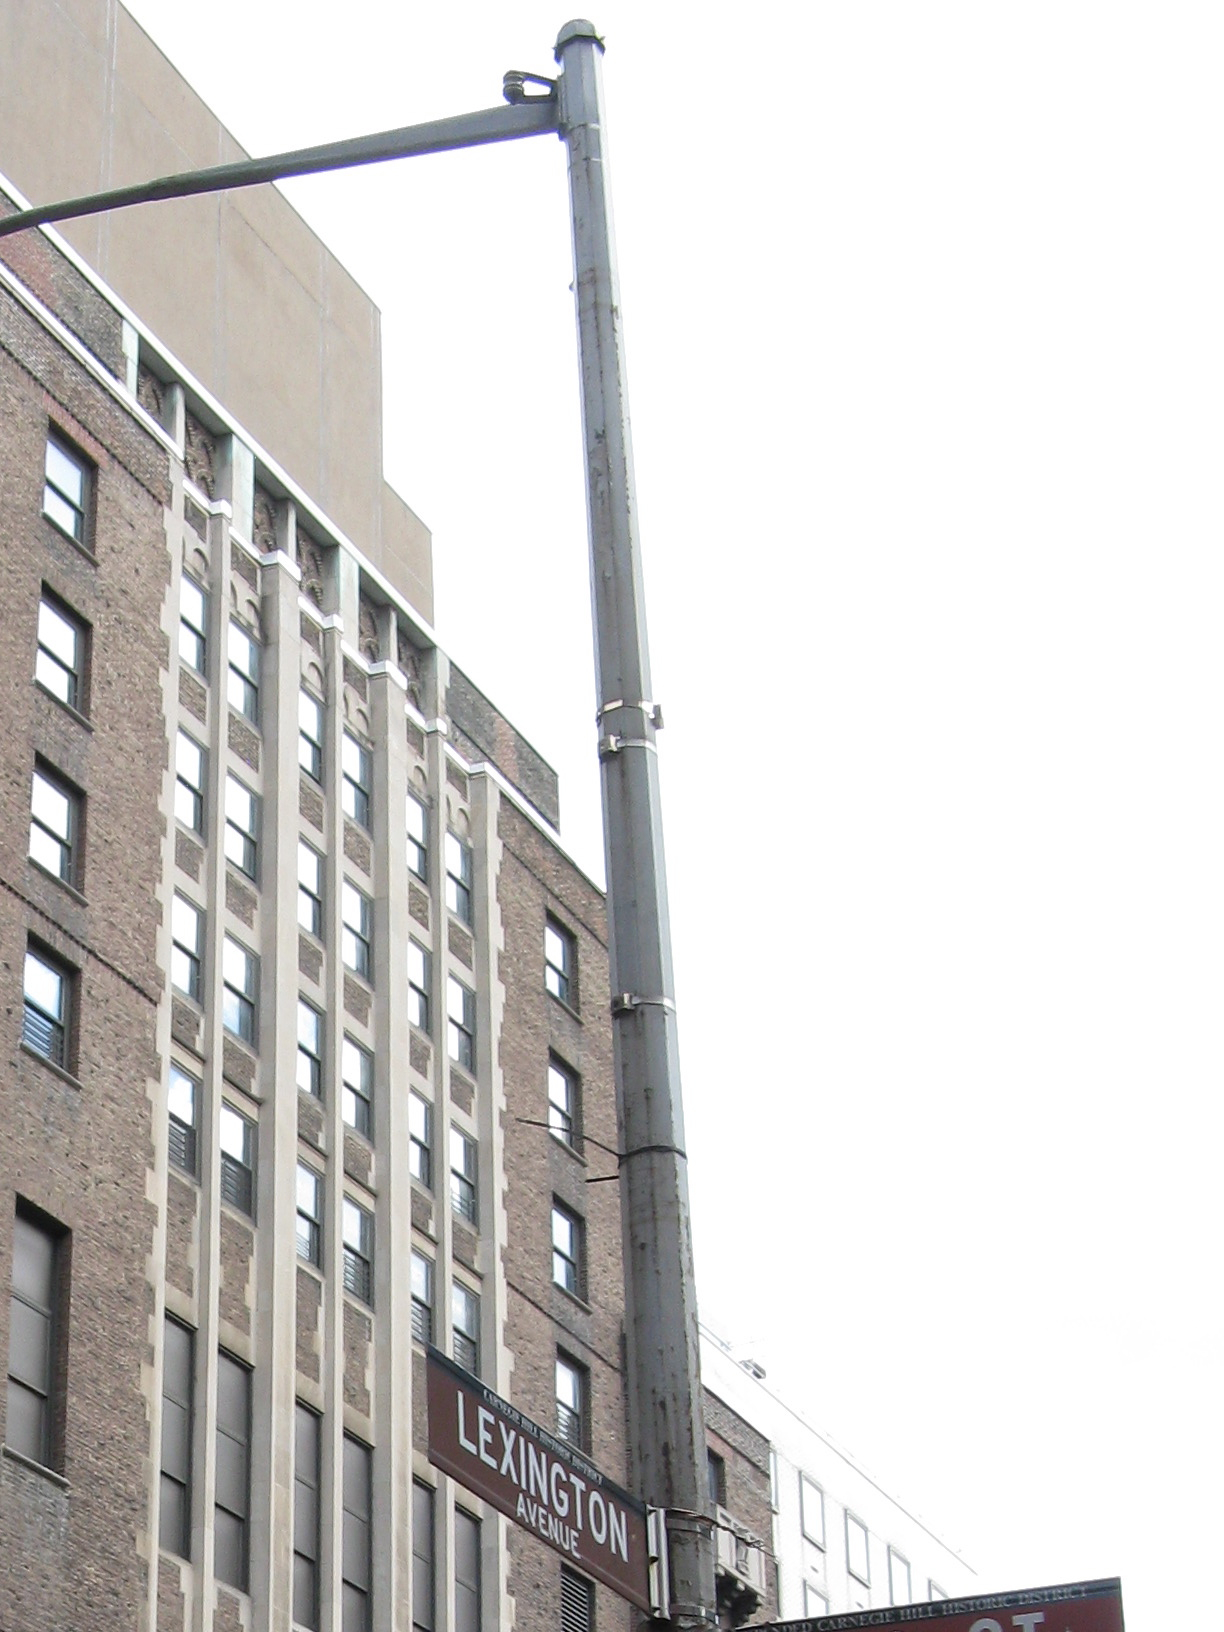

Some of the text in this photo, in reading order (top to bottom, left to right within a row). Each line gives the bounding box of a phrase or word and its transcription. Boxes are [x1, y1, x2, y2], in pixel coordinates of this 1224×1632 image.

[458, 1390, 628, 1563] LEXINGTON
[517, 1493, 581, 1559] AVENUE
[817, 1611, 895, 1632] CARNEGIE
[900, 1606, 935, 1621] HILL
[942, 1596, 1012, 1615] HISTORIC
[1017, 1587, 1088, 1605] DISTRICT
